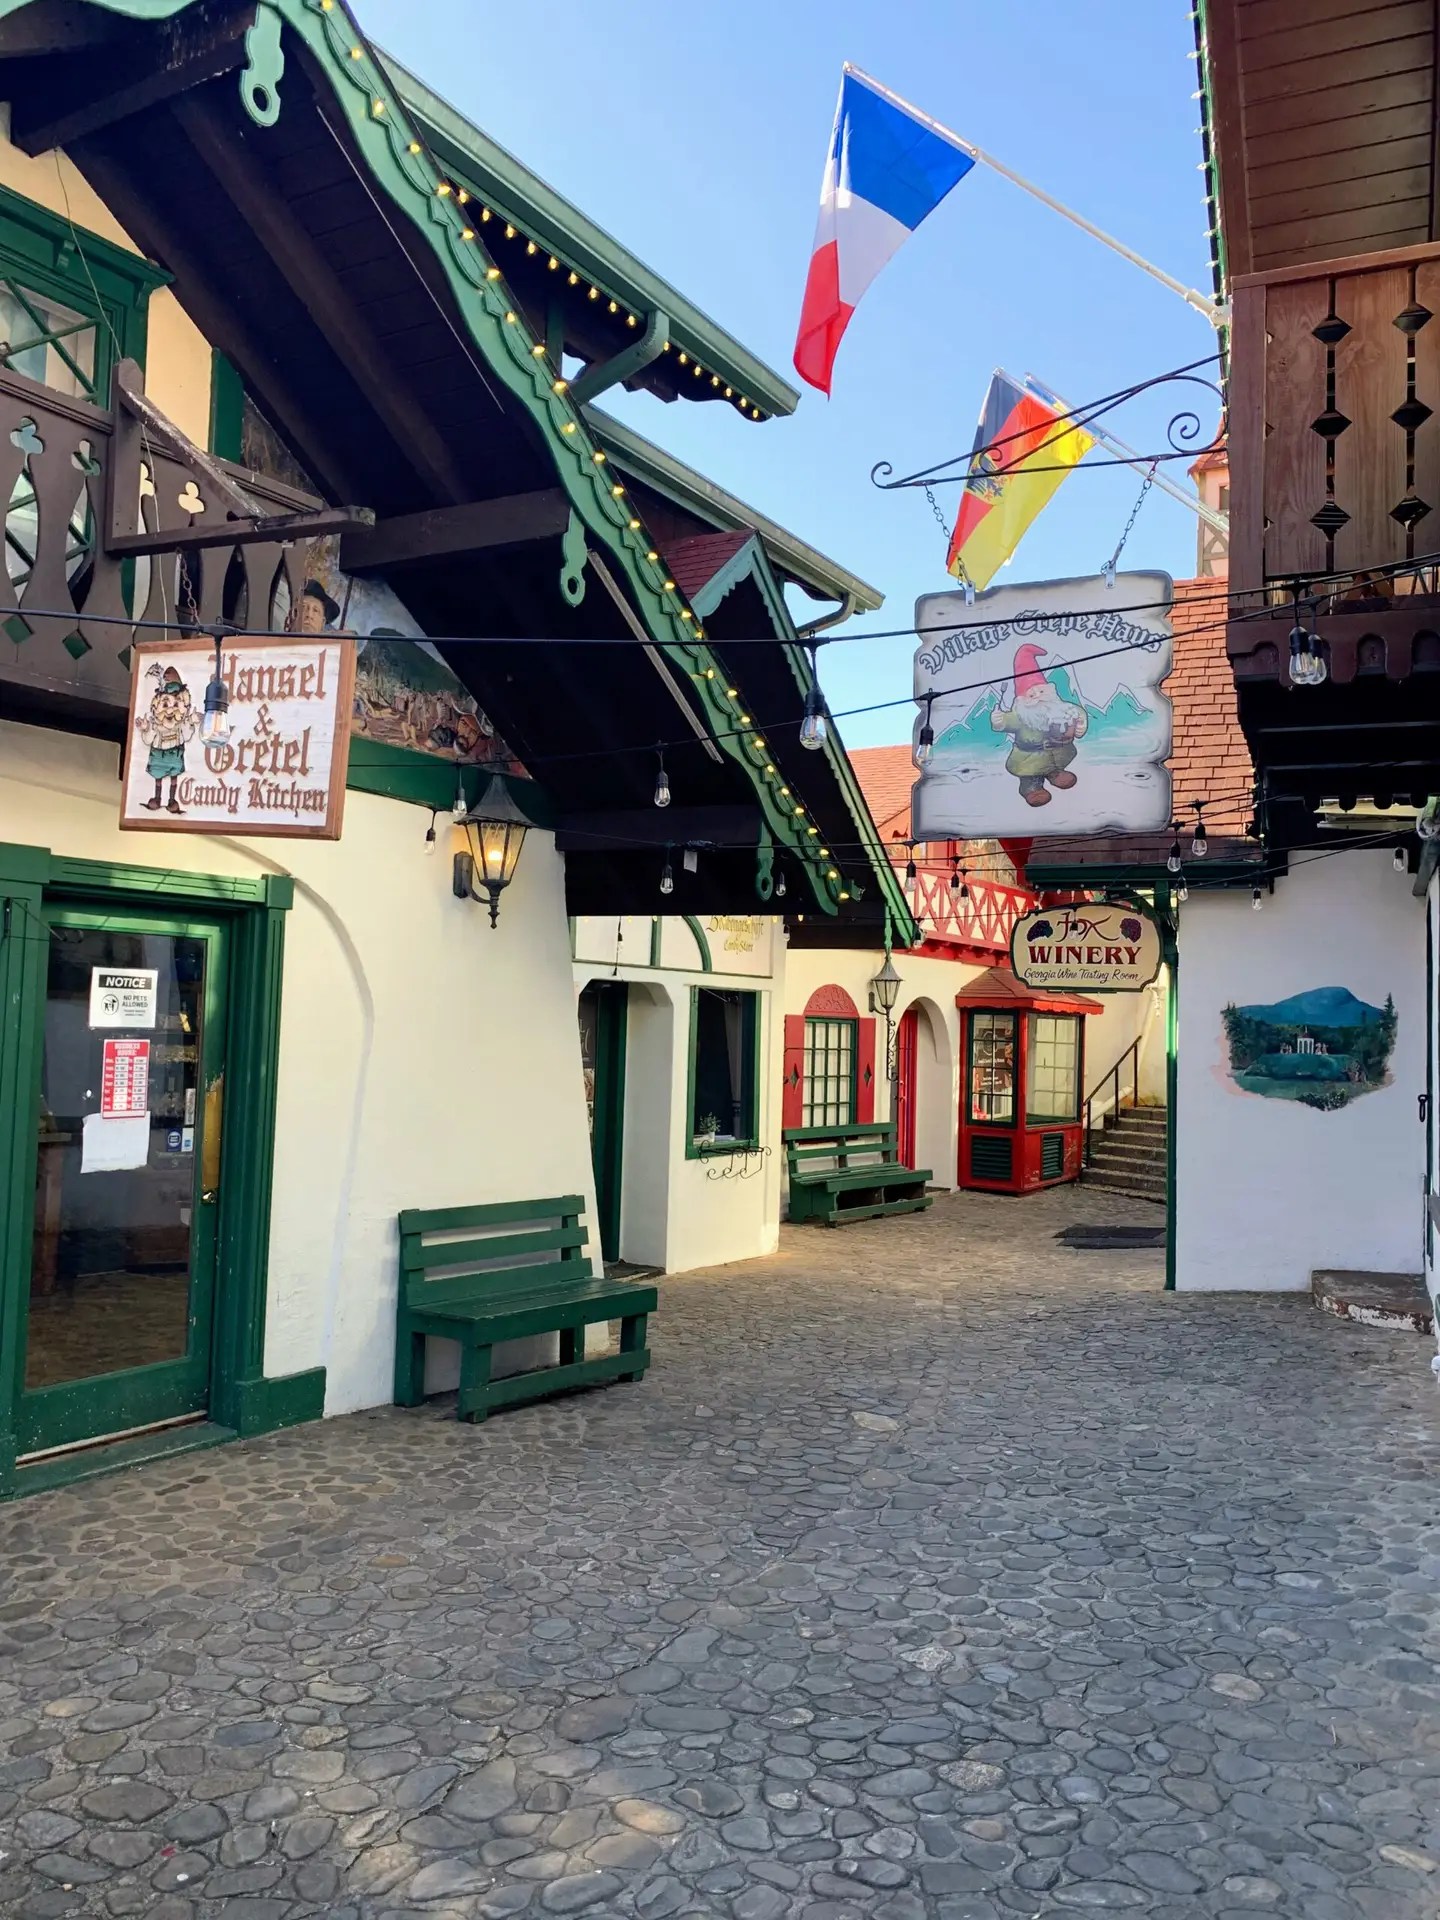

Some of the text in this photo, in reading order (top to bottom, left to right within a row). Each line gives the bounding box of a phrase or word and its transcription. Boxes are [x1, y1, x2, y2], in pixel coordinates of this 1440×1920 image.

[919, 622, 1011, 675] Village
[1085, 610, 1168, 653] Haus
[207, 649, 327, 702] Hansel
[253, 703, 273, 736] &
[178, 777, 327, 818] Candy Kitchen
[1028, 946, 1142, 965] WINERY
[105, 976, 146, 988] NOTICE
[1024, 968, 1140, 984] Georgia Wine Tasting Room
